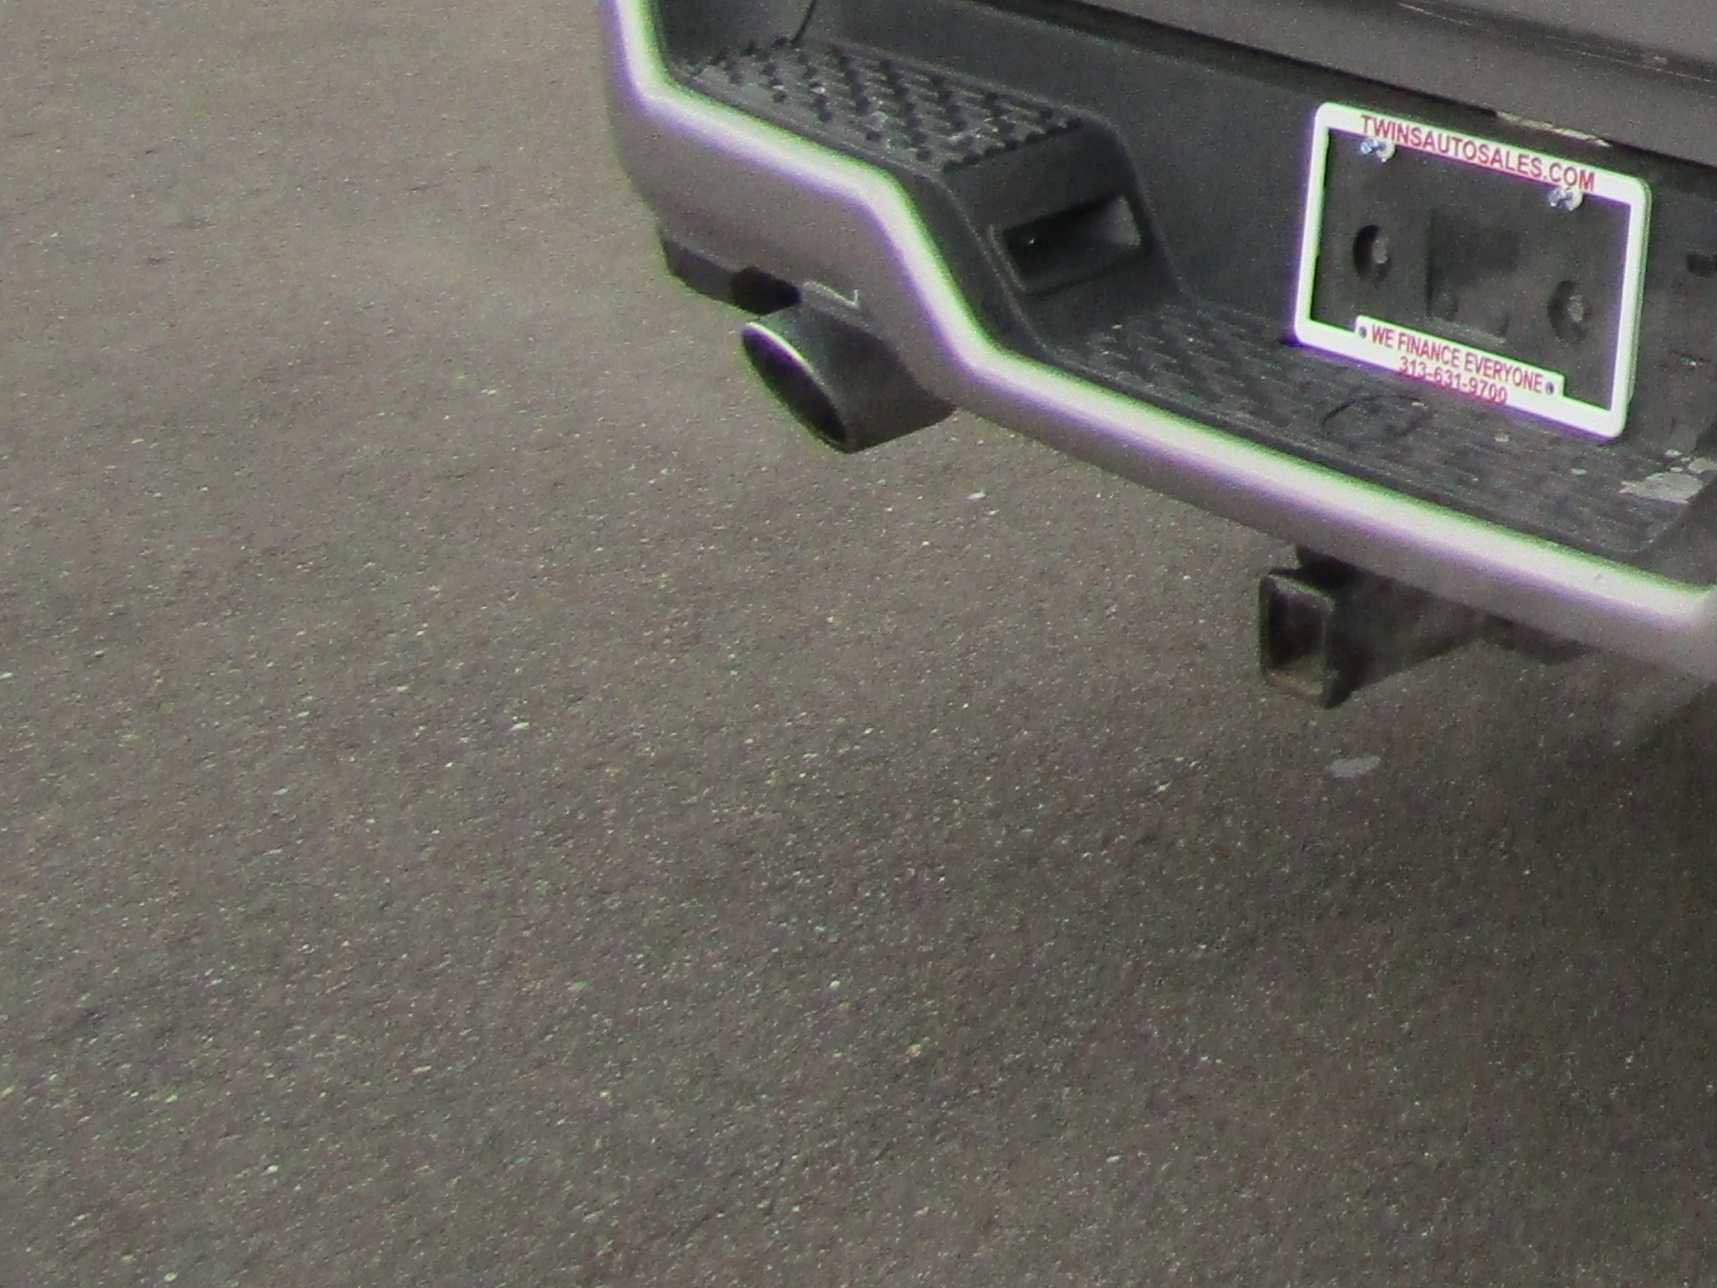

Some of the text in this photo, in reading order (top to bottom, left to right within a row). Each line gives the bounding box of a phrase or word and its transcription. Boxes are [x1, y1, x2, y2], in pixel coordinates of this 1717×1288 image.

[1360, 114, 1595, 191] TWINSAUTOSALES.COM
[1372, 323, 1544, 393] WE FINANCE EVERYONE
[1399, 355, 1508, 405] 313-631-9700
